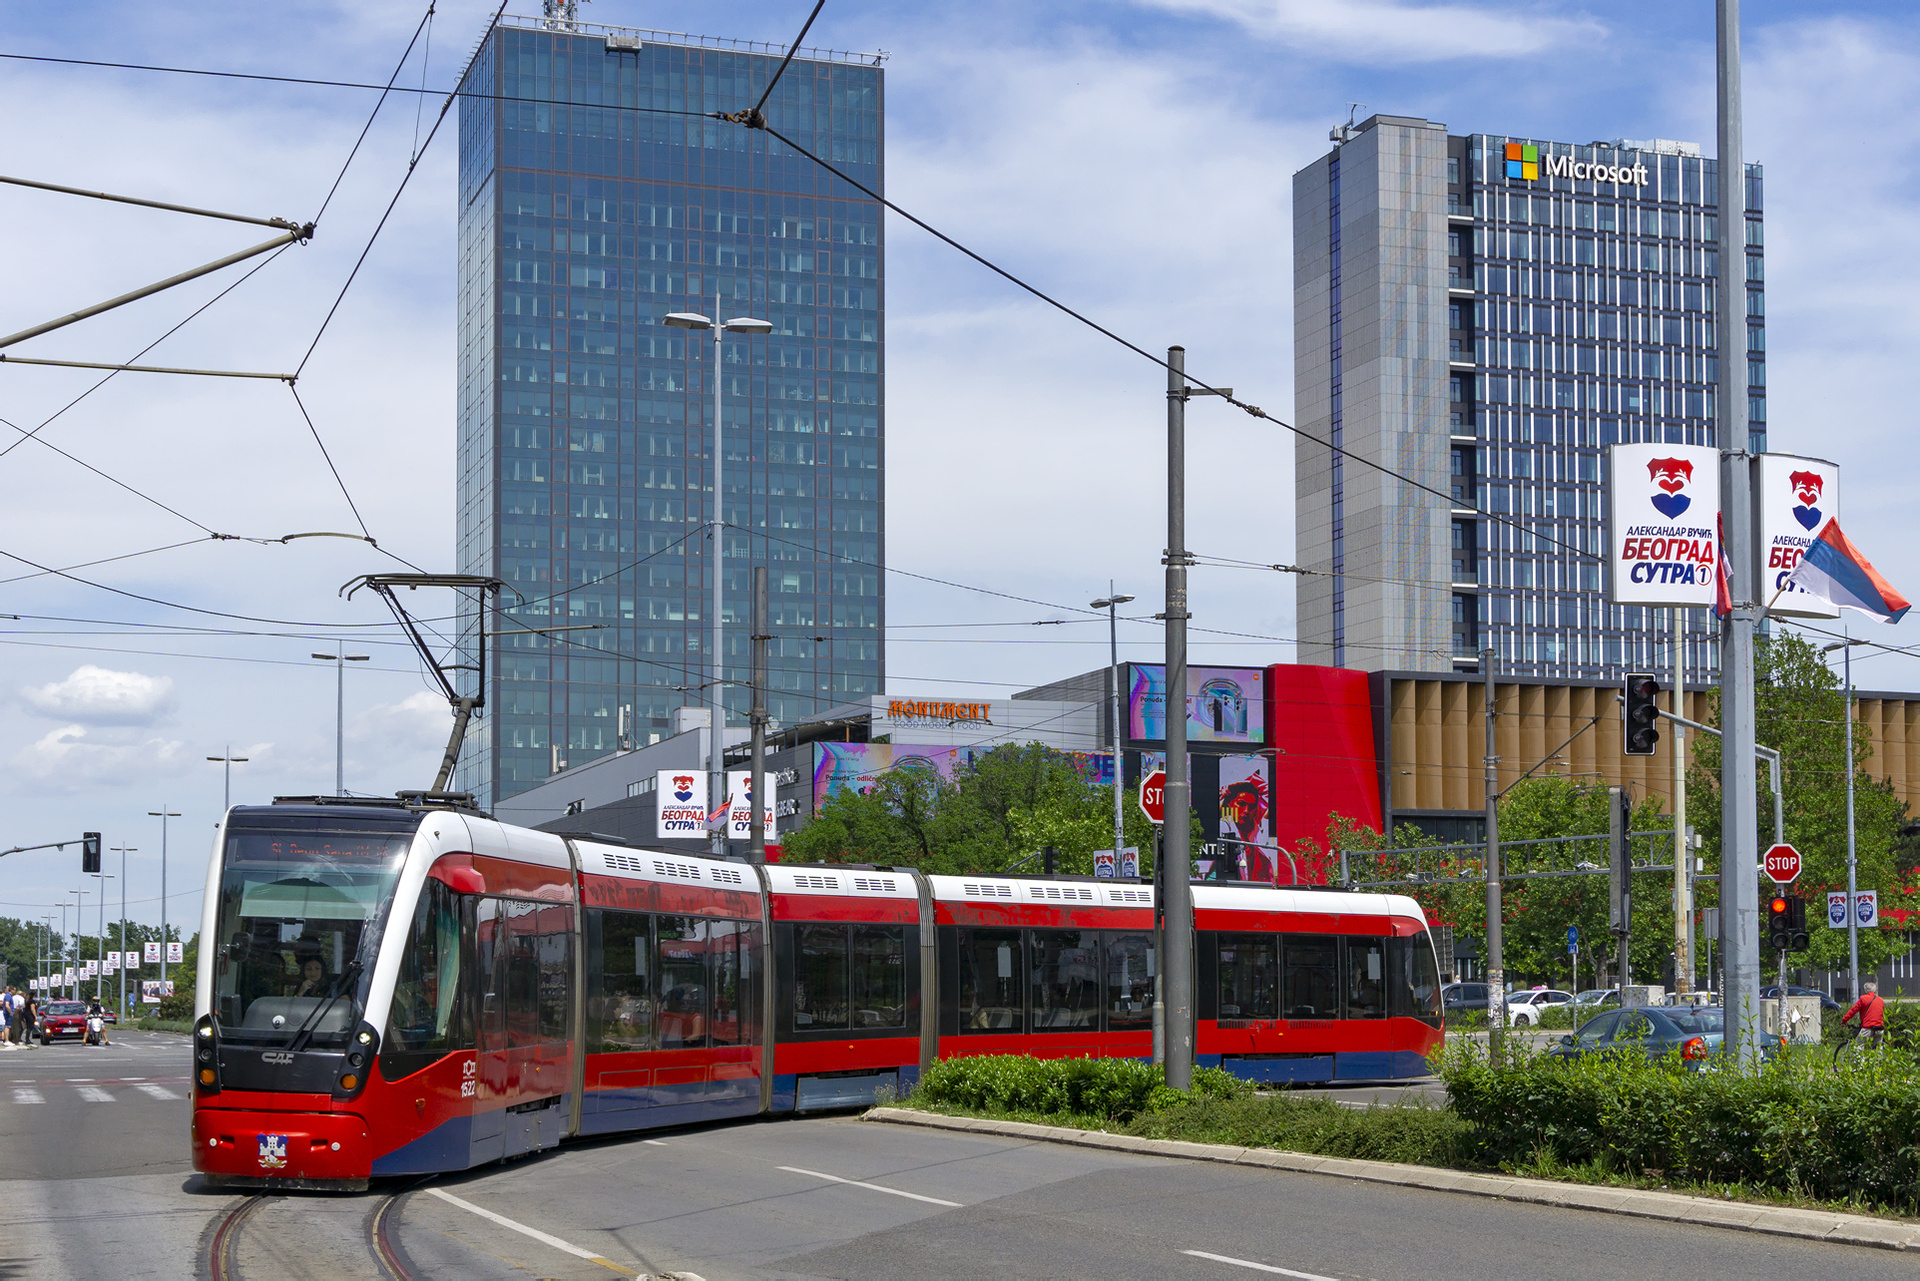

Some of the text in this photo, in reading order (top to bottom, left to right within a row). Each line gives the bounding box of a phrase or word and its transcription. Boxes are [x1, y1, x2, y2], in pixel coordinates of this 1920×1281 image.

[1546, 153, 1648, 186] Microsoft
[1626, 526, 1713, 539] АЛЕКСАНДАР ВУЧИЋ
[1772, 535, 1815, 547] АЛЕКСАНД
[1621, 537, 1714, 564] БЕОГРАД
[1630, 562, 1695, 585] СУТРА
[1140, 695, 1163, 703] Ponuda
[888, 699, 991, 720] MONUMENT
[893, 720, 919, 729] GOOD
[920, 721, 947, 730] MOOD
[957, 722, 982, 730] FOOD
[1146, 787, 1165, 805] ST
[661, 810, 705, 821] БЕОГРАД
[664, 821, 695, 830] СУТРА
[1768, 857, 1797, 870] STOP
[460, 1080, 475, 1098] 1522
